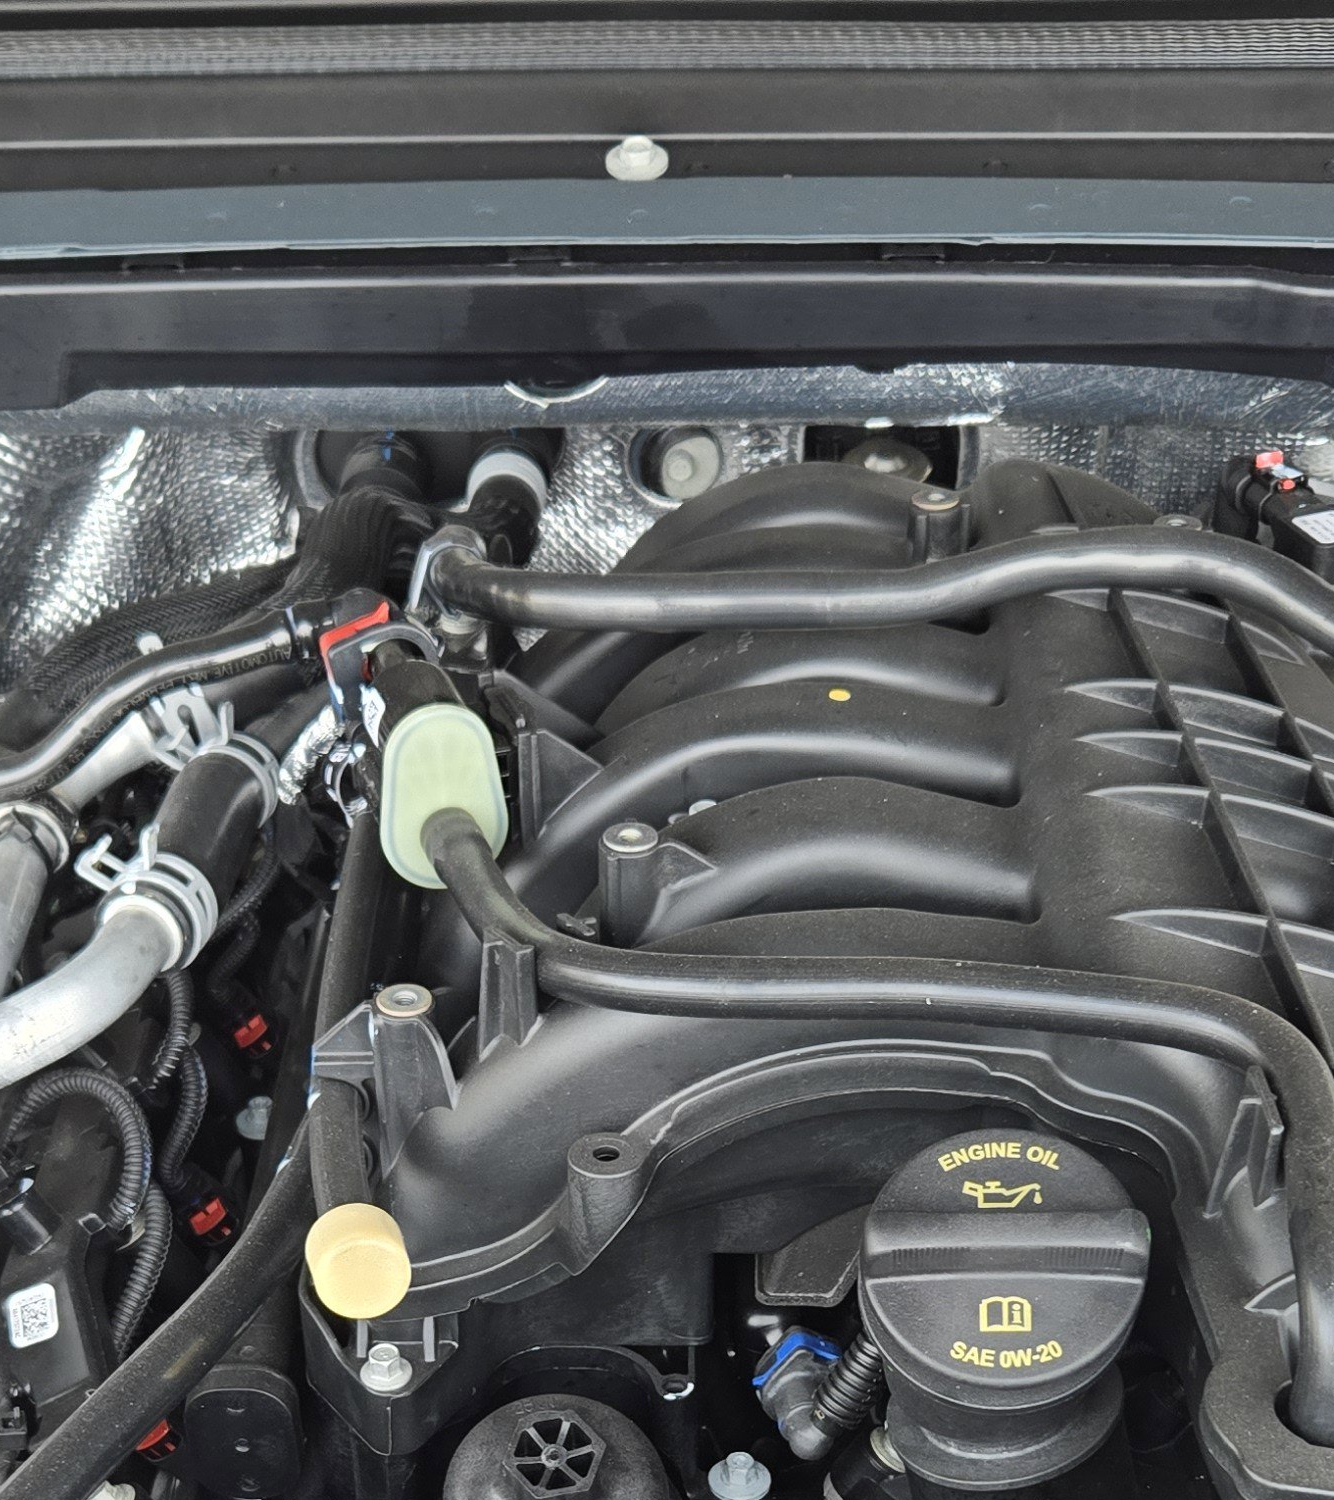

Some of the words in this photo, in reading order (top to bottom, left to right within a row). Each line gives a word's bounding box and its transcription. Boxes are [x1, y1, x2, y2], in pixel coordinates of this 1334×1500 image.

[214, 648, 292, 678] AUTOMOTIVE
[937, 1142, 1021, 1172] ENGINE
[1026, 1145, 1060, 1171] OIL
[950, 1340, 995, 1368] SAE
[999, 1340, 1063, 1369] 0W-20
